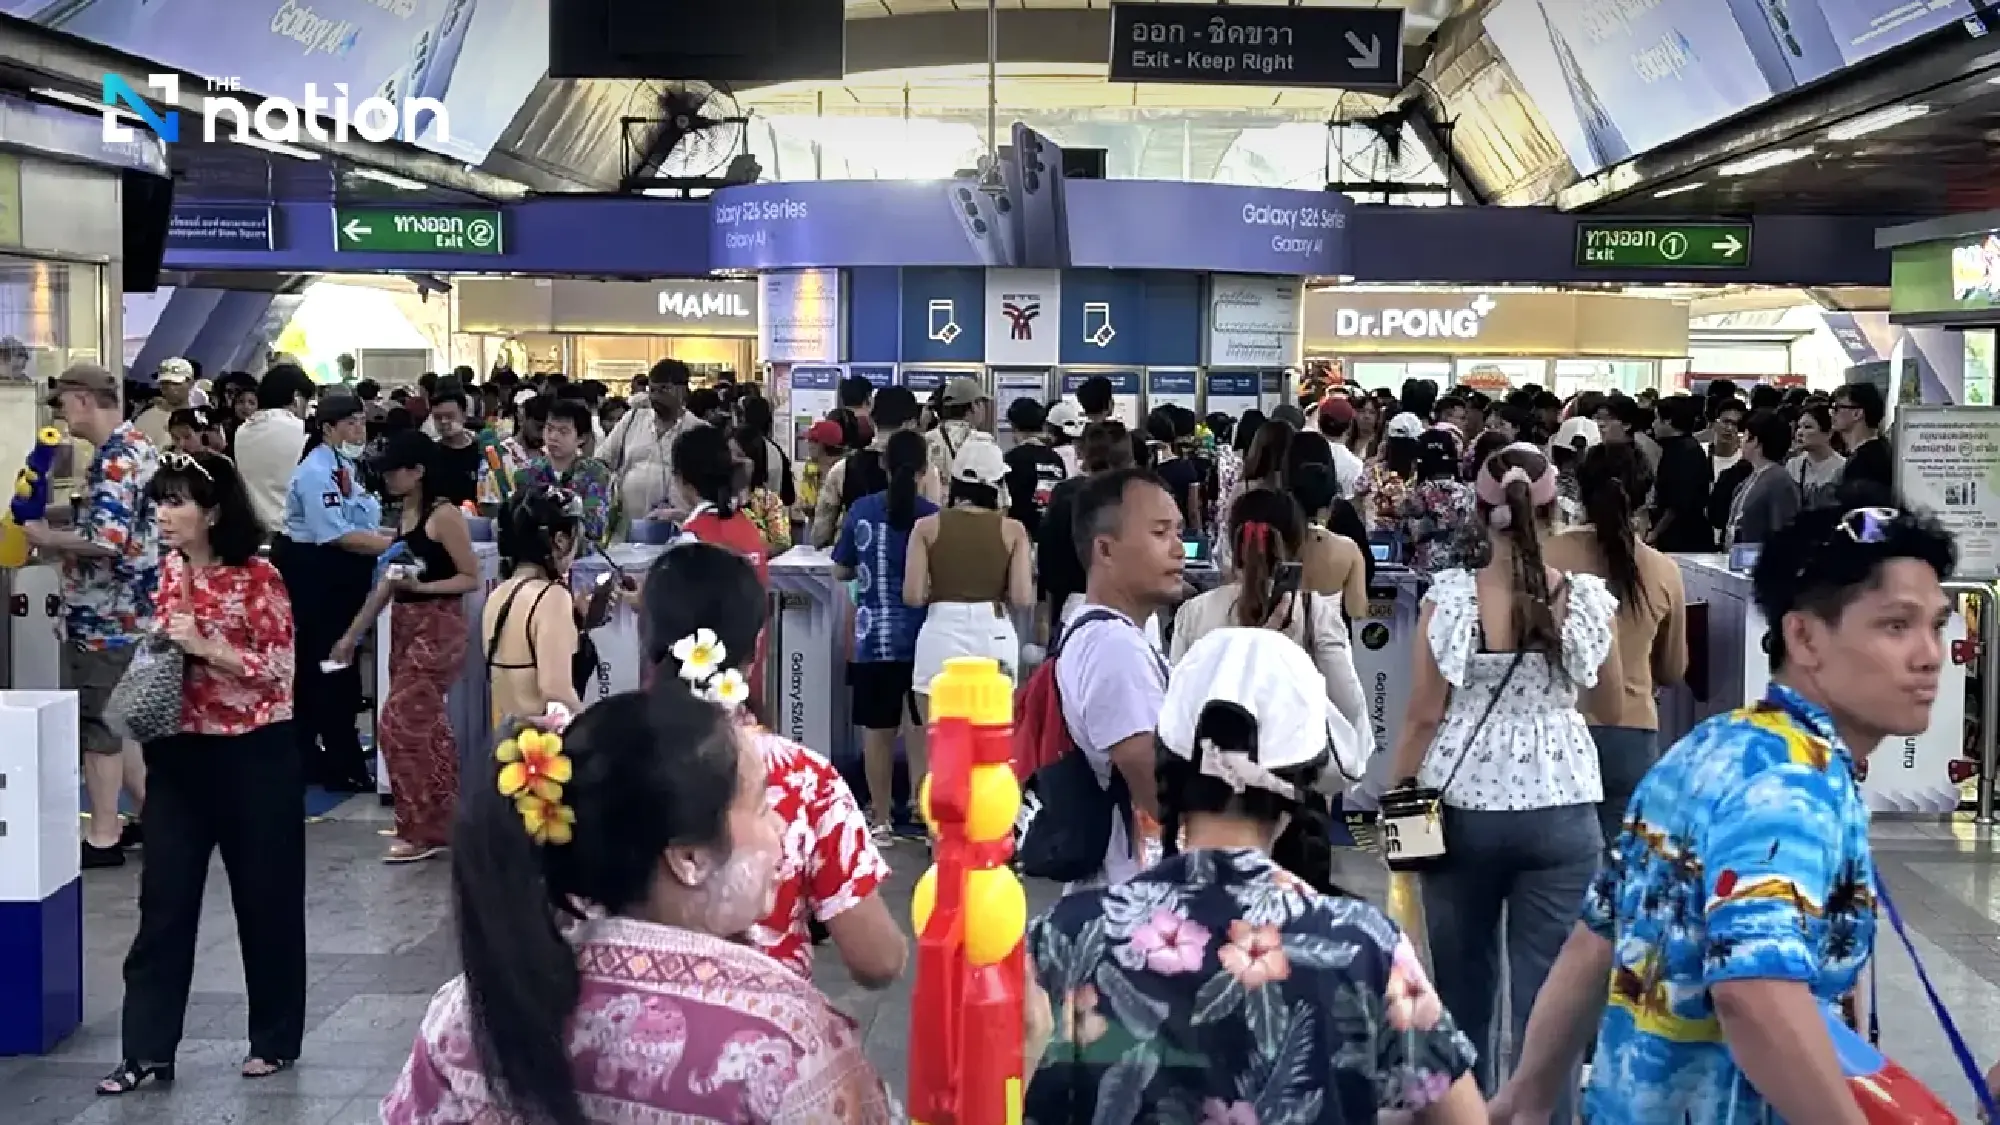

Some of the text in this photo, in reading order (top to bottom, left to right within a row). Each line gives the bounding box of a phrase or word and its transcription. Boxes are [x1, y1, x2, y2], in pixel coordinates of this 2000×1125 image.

[1132, 22, 1185, 43] ออก
[1207, 15, 1293, 46] ชิดขวา
[1132, 51, 1168, 68] Exit
[1187, 51, 1235, 72] Keep
[1243, 53, 1293, 73] Right
[763, 199, 807, 219] Series
[1242, 203, 1298, 231] Galaxy
[394, 215, 463, 232] ทางออก
[436, 234, 463, 248] Exit
[1585, 230, 1656, 246] ทางออก
[1585, 248, 1615, 260] Exit
[788, 652, 804, 700] Galaxy
[1371, 672, 1387, 722] Galaxy
